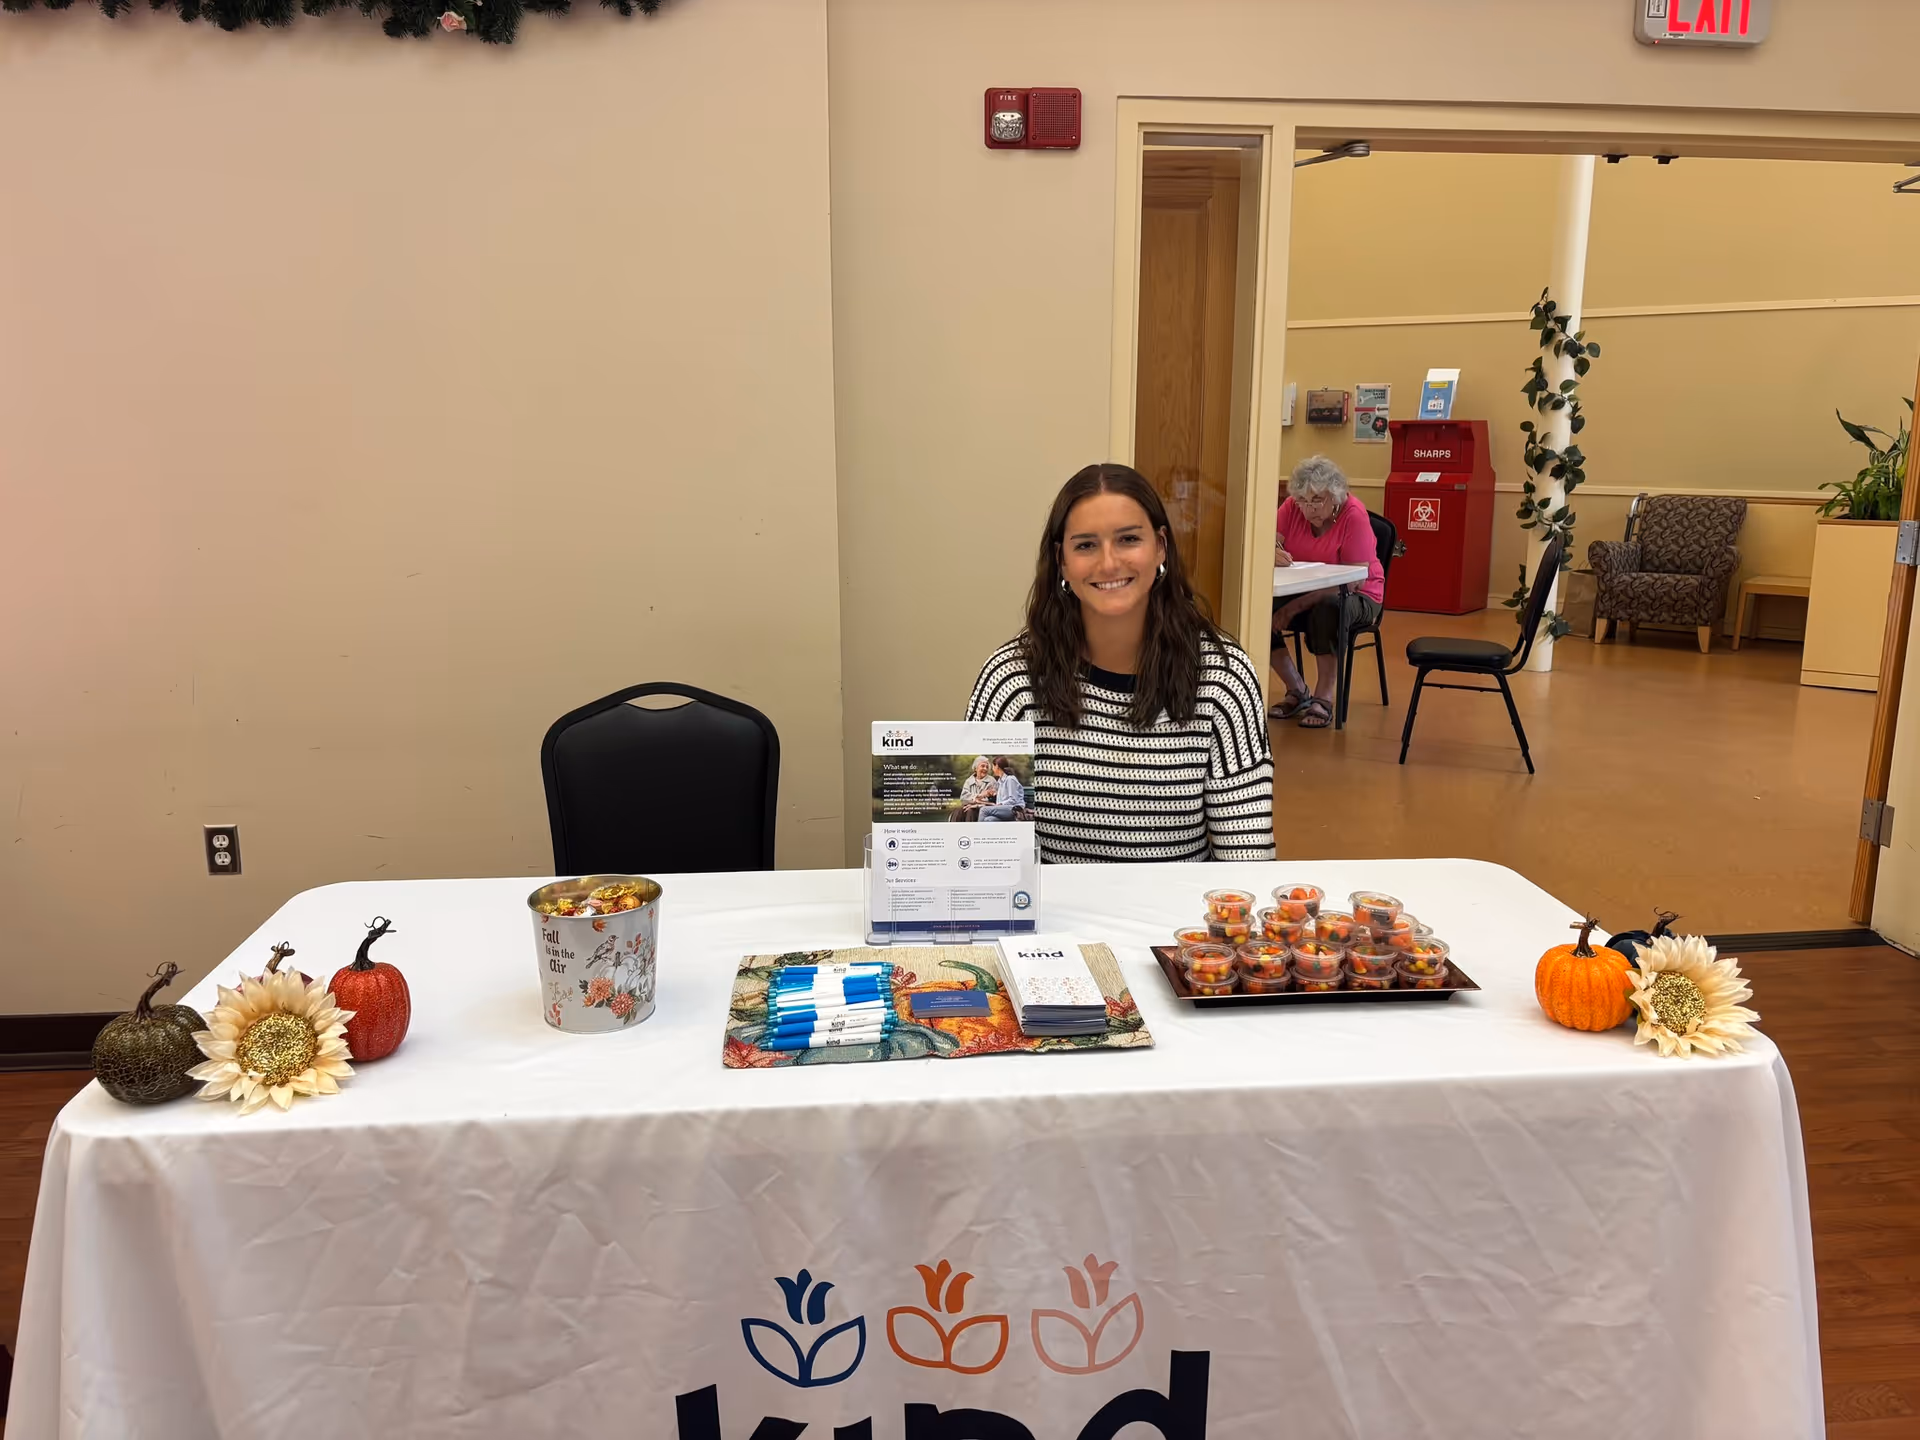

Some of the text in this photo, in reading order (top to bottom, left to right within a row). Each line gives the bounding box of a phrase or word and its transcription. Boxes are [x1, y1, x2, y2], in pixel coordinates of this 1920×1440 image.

[1413, 449, 1451, 459] SHARPS
[1410, 521, 1437, 529] BIOHAZARD
[882, 736, 913, 747] kind
[542, 928, 560, 945] Fall
[552, 946, 560, 958] in
[561, 948, 575, 960] the
